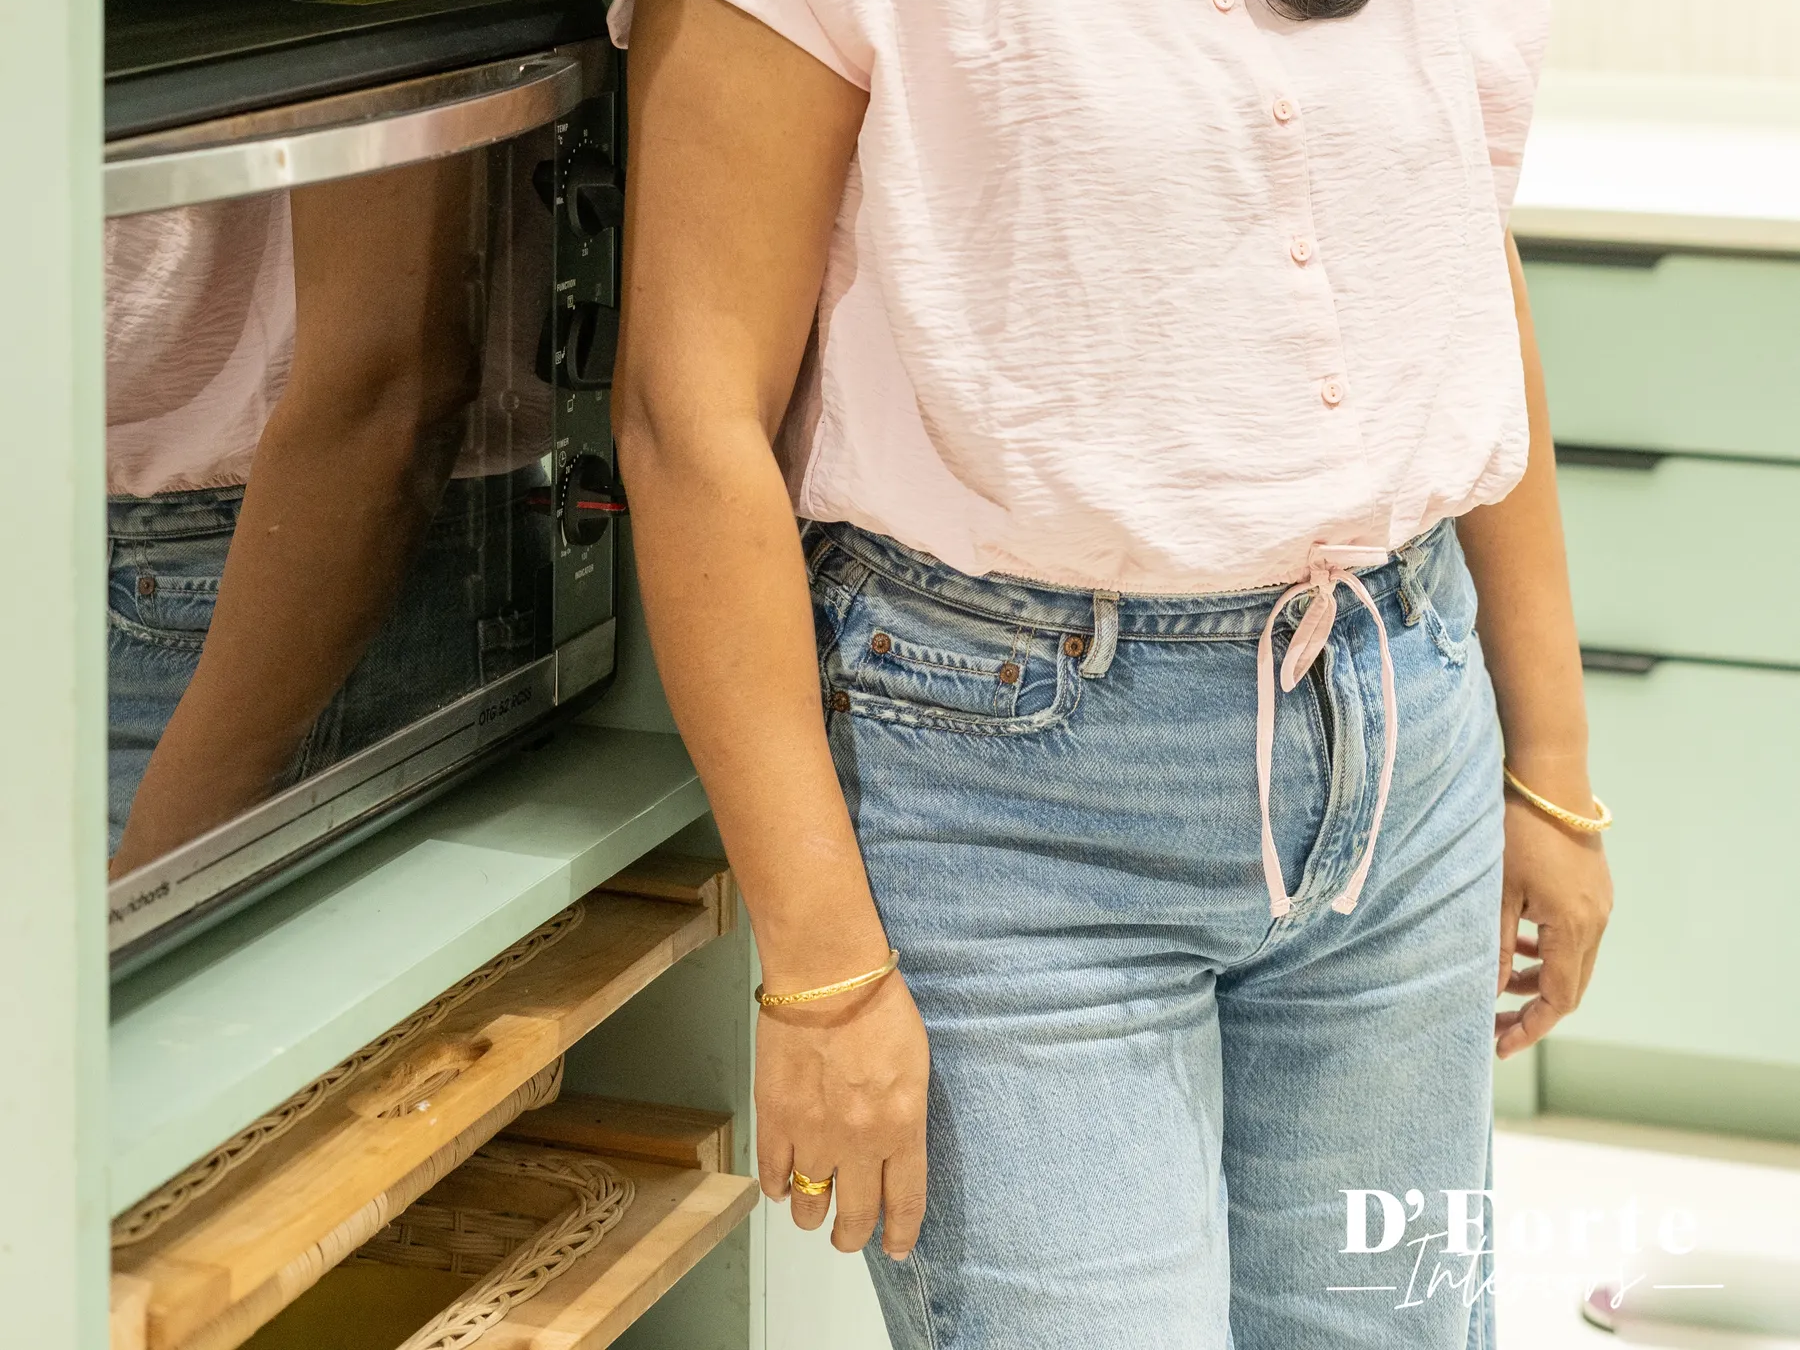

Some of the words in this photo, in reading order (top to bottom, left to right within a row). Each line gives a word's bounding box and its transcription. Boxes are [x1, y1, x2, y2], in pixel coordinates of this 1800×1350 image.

[557, 123, 569, 134] TEMP
[556, 279, 577, 292] FUNCTION
[556, 437, 570, 450] TIMER
[478, 704, 497, 726] OTG
